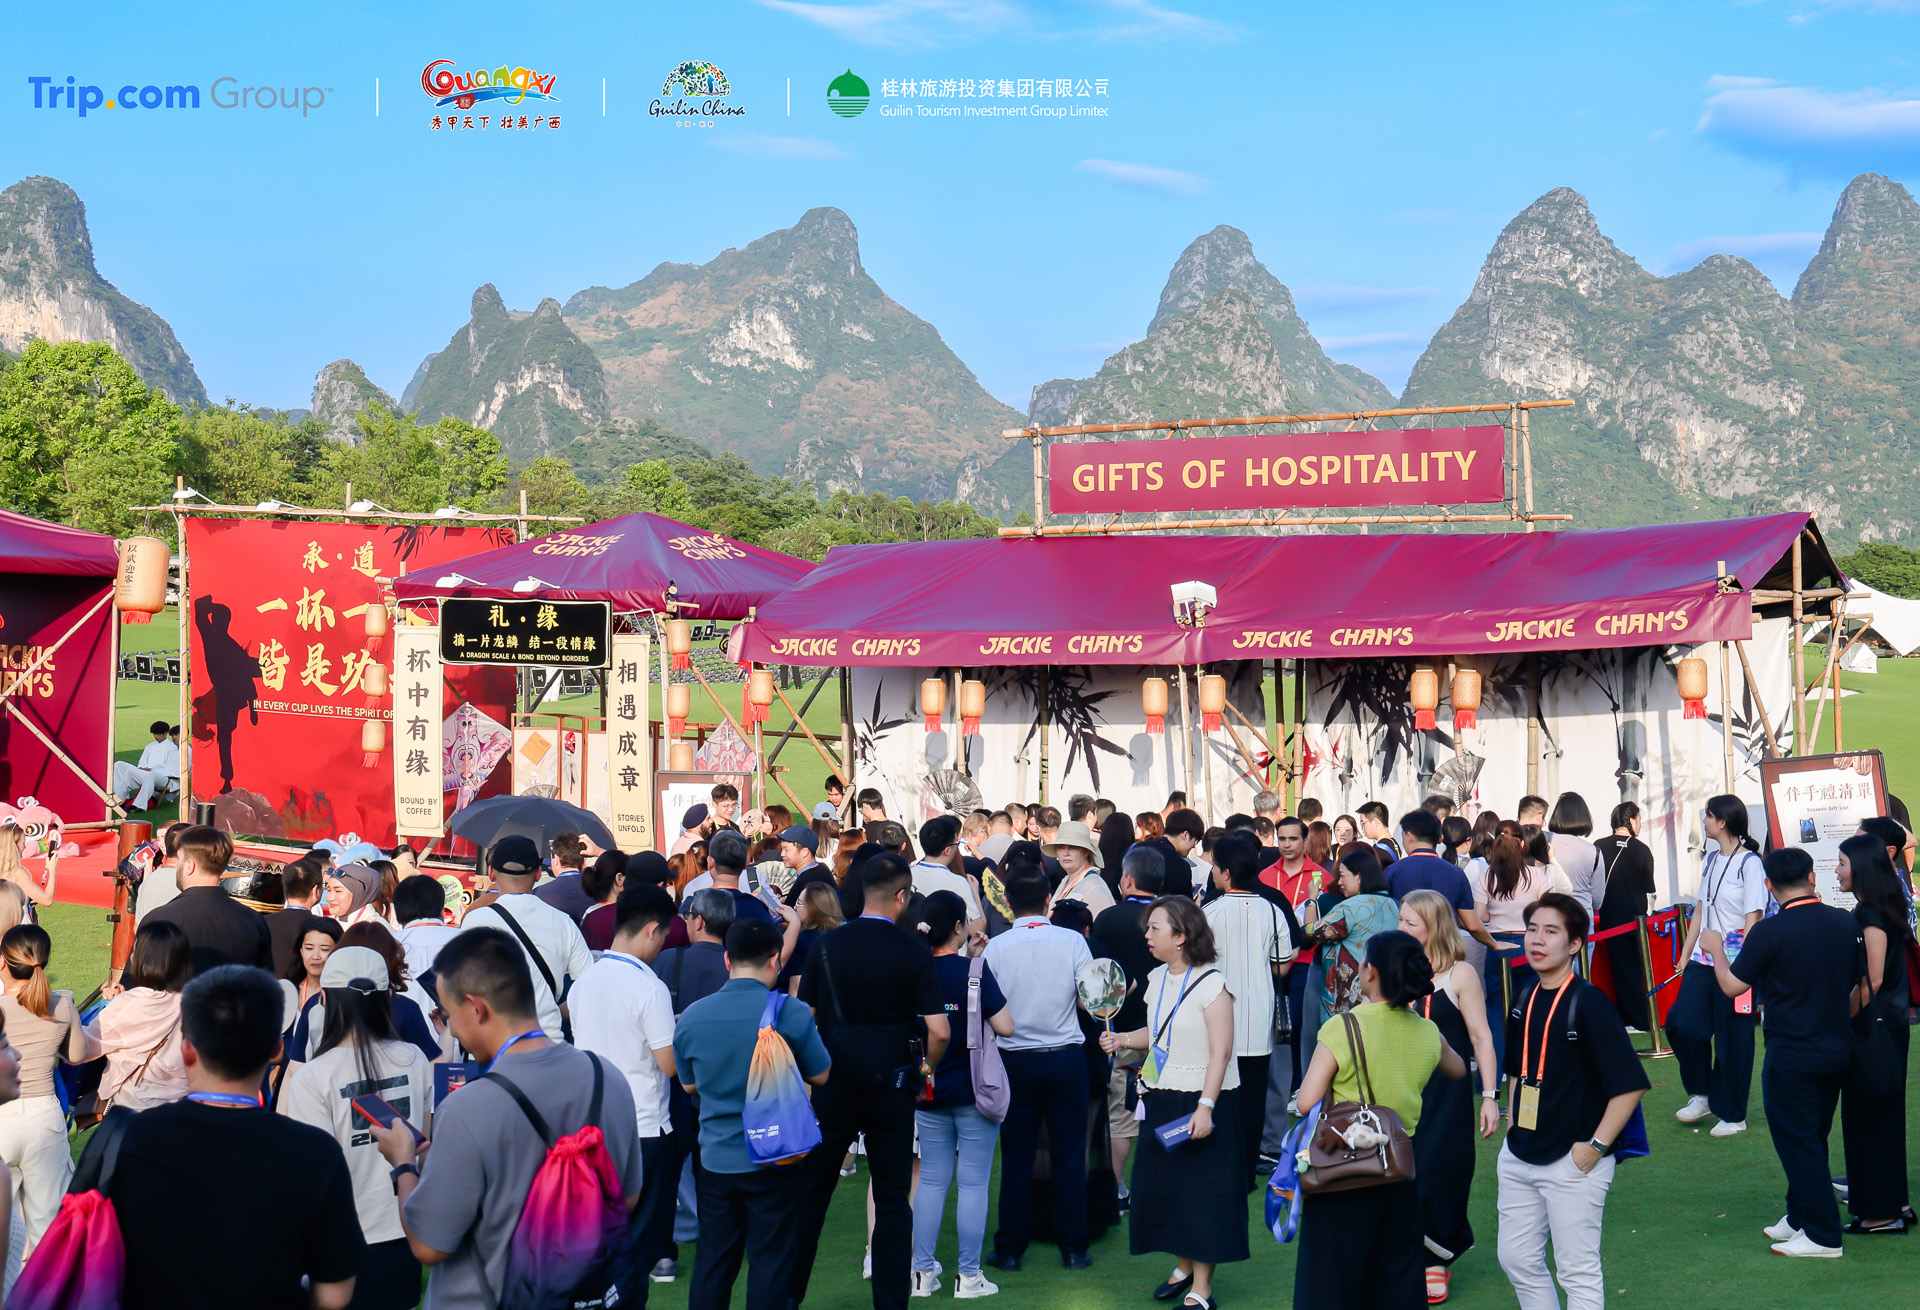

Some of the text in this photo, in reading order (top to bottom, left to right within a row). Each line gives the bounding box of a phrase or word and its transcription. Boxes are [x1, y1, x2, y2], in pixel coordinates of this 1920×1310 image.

[1072, 450, 1477, 493] GIFTS OF HOSPITALITY
[546, 533, 625, 547] JACKIE
[667, 533, 725, 551] JACKIE
[532, 543, 611, 557] CHAN'S
[682, 542, 747, 560] CHAN'S
[488, 604, 559, 631] 礼·缘
[1485, 610, 1689, 642] JACKIE CHAN'S
[453, 633, 597, 651] 摘一片龙鳞 结一段情缘
[979, 634, 1143, 655] JACKIE CHAN'S
[1232, 627, 1414, 648] JACKIE CHAN'S
[771, 638, 921, 657] JACKIE CHAN'S
[258, 638, 394, 696] 皆是功
[253, 699, 262, 709] IN
[263, 700, 290, 711] EVERY
[291, 702, 309, 712] CUP
[310, 705, 334, 715] LIVES
[335, 706, 352, 717] THE
[354, 708, 381, 718] SPIRIT
[405, 648, 431, 776] 杯中有缘
[617, 659, 640, 792] 相遇成章
[400, 796, 438, 806] BOUND BY
[406, 806, 432, 816] COFFEE
[617, 813, 645, 823] STORIES
[617, 824, 646, 833] UNFOLD
